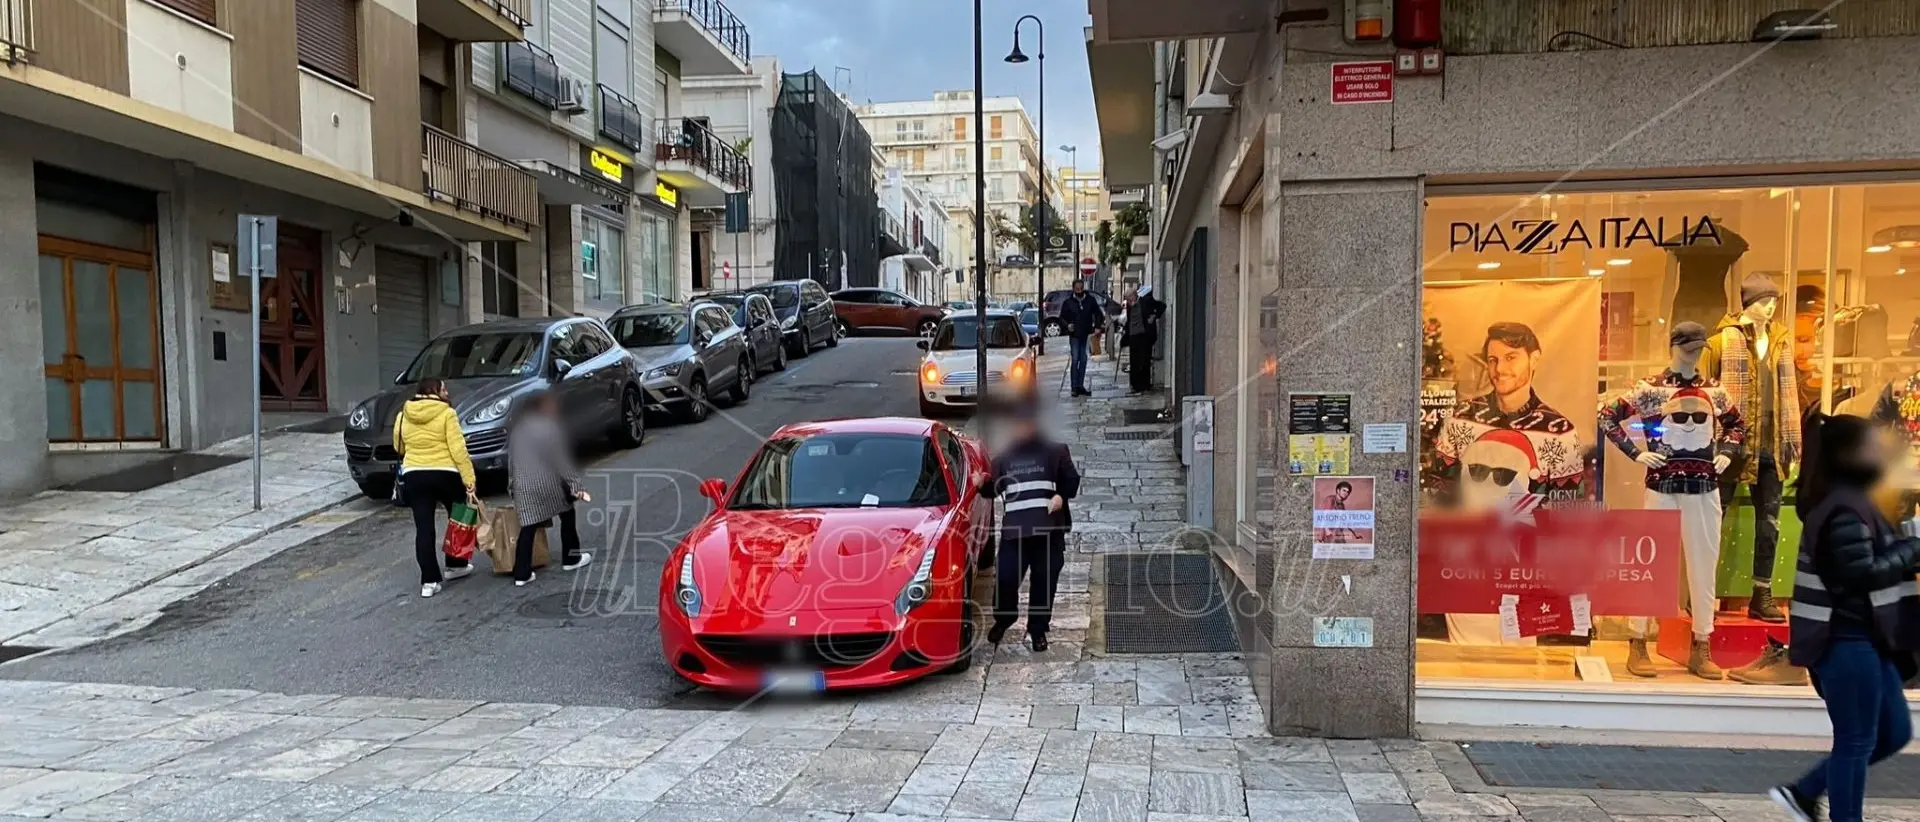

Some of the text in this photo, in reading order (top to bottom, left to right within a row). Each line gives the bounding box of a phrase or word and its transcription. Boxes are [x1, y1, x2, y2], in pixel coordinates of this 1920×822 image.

[1364, 82, 1379, 90] SOLO
[1450, 214, 1722, 255] PIAZZA ITALIA
[1548, 489, 1578, 501] OGNI
[1440, 567, 1486, 580] OGNI
